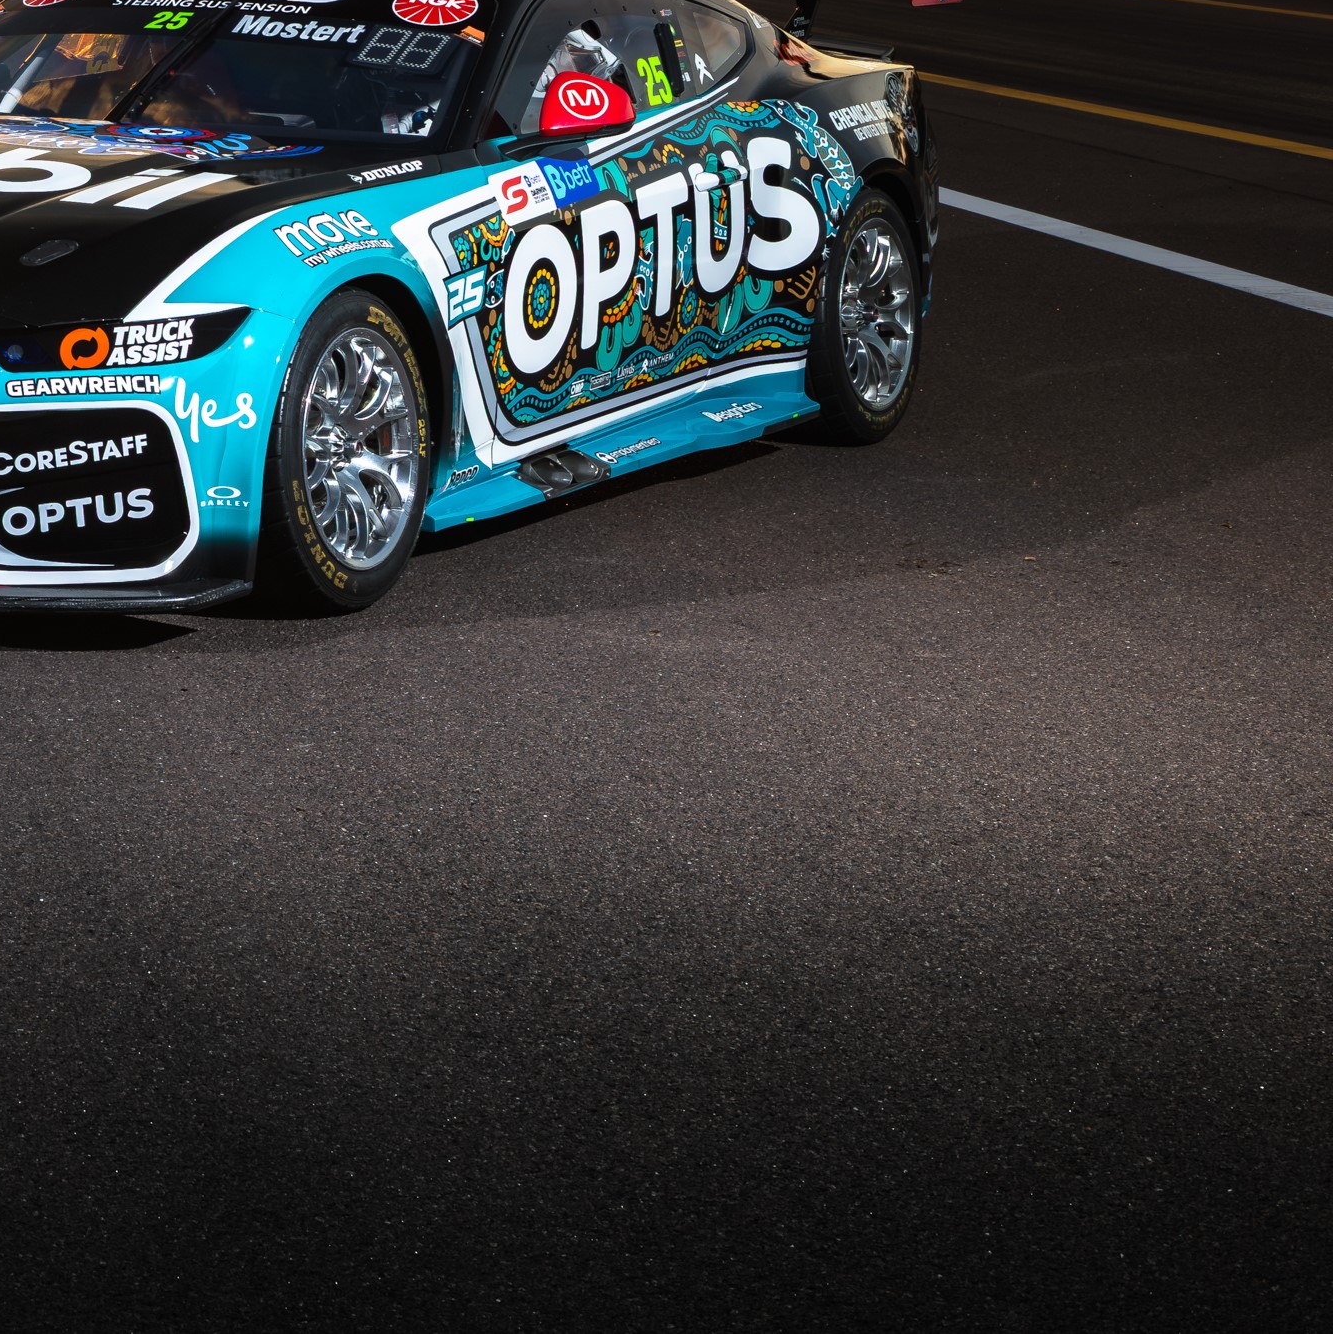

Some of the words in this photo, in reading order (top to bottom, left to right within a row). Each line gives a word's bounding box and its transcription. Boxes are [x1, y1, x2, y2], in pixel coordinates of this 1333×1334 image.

[143, 12, 195, 30] 25
[231, 15, 366, 44] Mostert
[636, 55, 673, 106] 25
[566, 89, 600, 107] M
[829, 103, 879, 131] CHEMICAL
[361, 160, 423, 181] DUNLOP
[558, 162, 593, 191] betr
[273, 209, 379, 257] move
[503, 136, 821, 375] OPTUS
[448, 269, 484, 322] 25
[113, 318, 195, 346] TRUCK
[367, 306, 408, 354] SPORT
[106, 339, 193, 366] ASSIST
[648, 352, 674, 367] ANTHEM
[6, 374, 161, 397] GEARWRENCH
[571, 382, 584, 395] OMP
[174, 377, 257, 443] yes
[450, 464, 479, 490] Repco
[2, 487, 155, 536] OPTUS
[292, 480, 348, 590] DUNLOP
